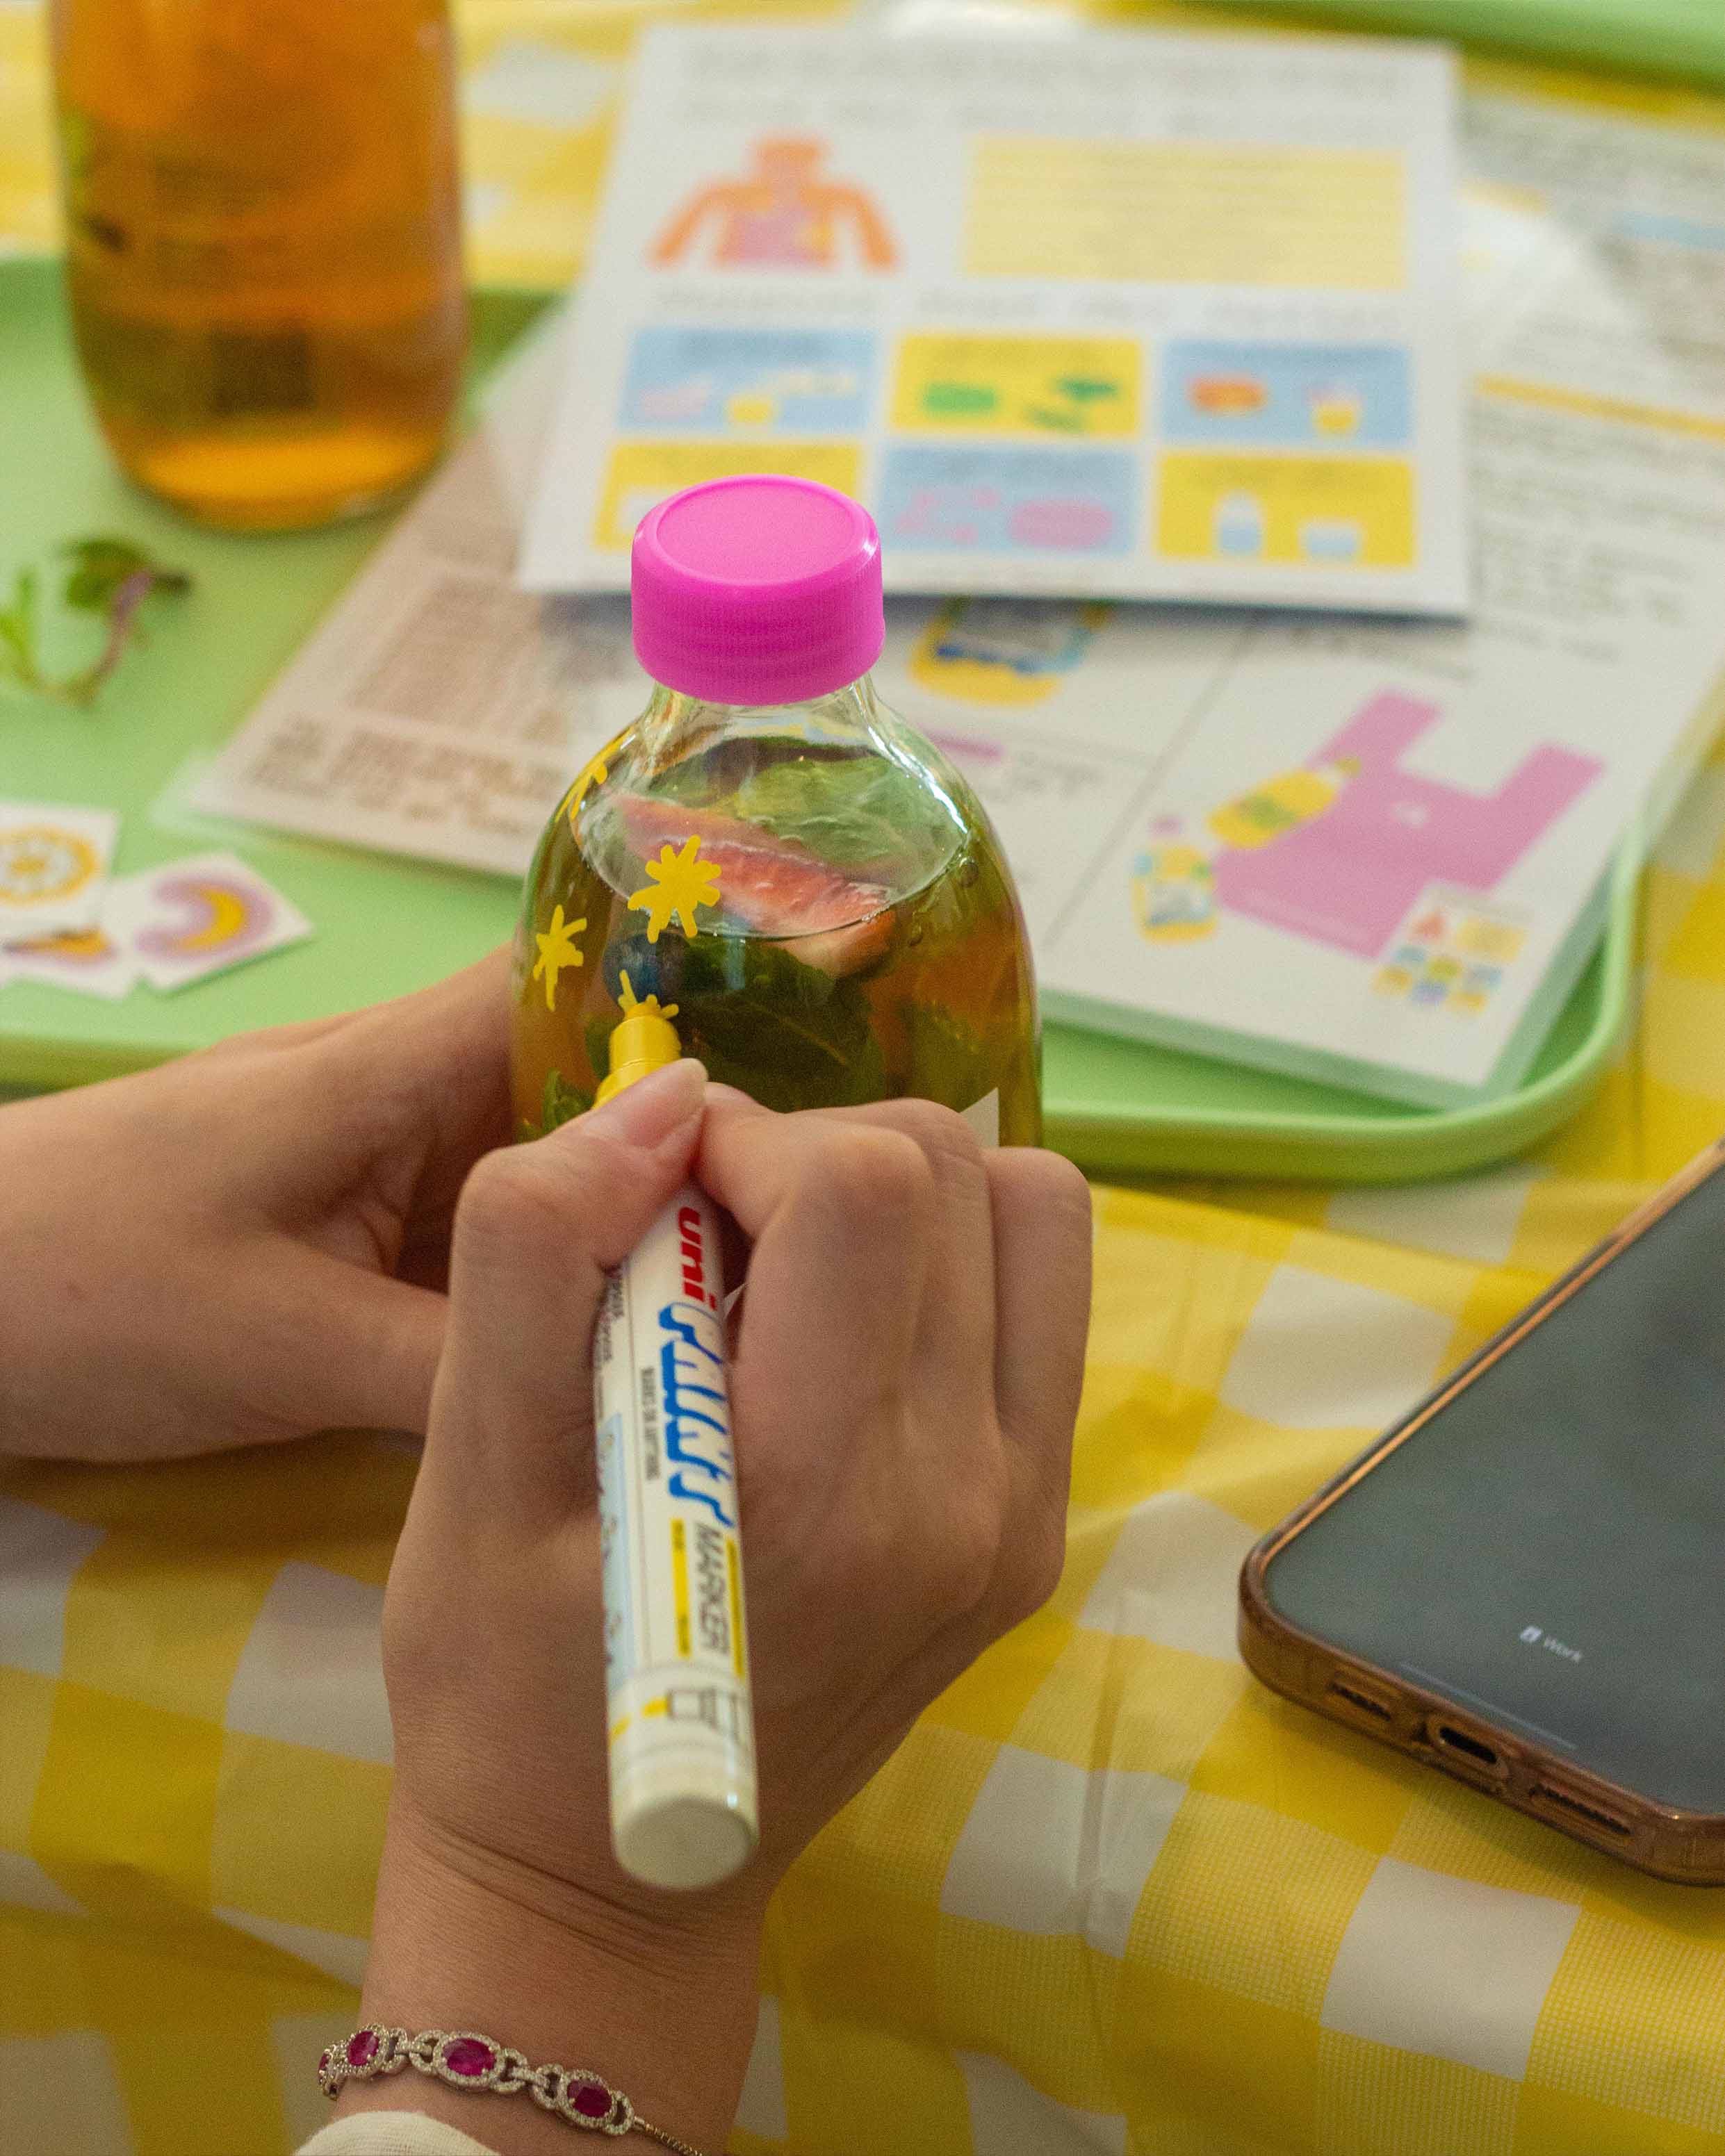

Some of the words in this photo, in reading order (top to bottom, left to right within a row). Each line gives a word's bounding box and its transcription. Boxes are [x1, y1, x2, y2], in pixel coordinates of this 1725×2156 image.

[678, 1205, 718, 1312] uni
[658, 1301, 735, 1527] PAINT
[695, 1522, 730, 1655] MARKER
